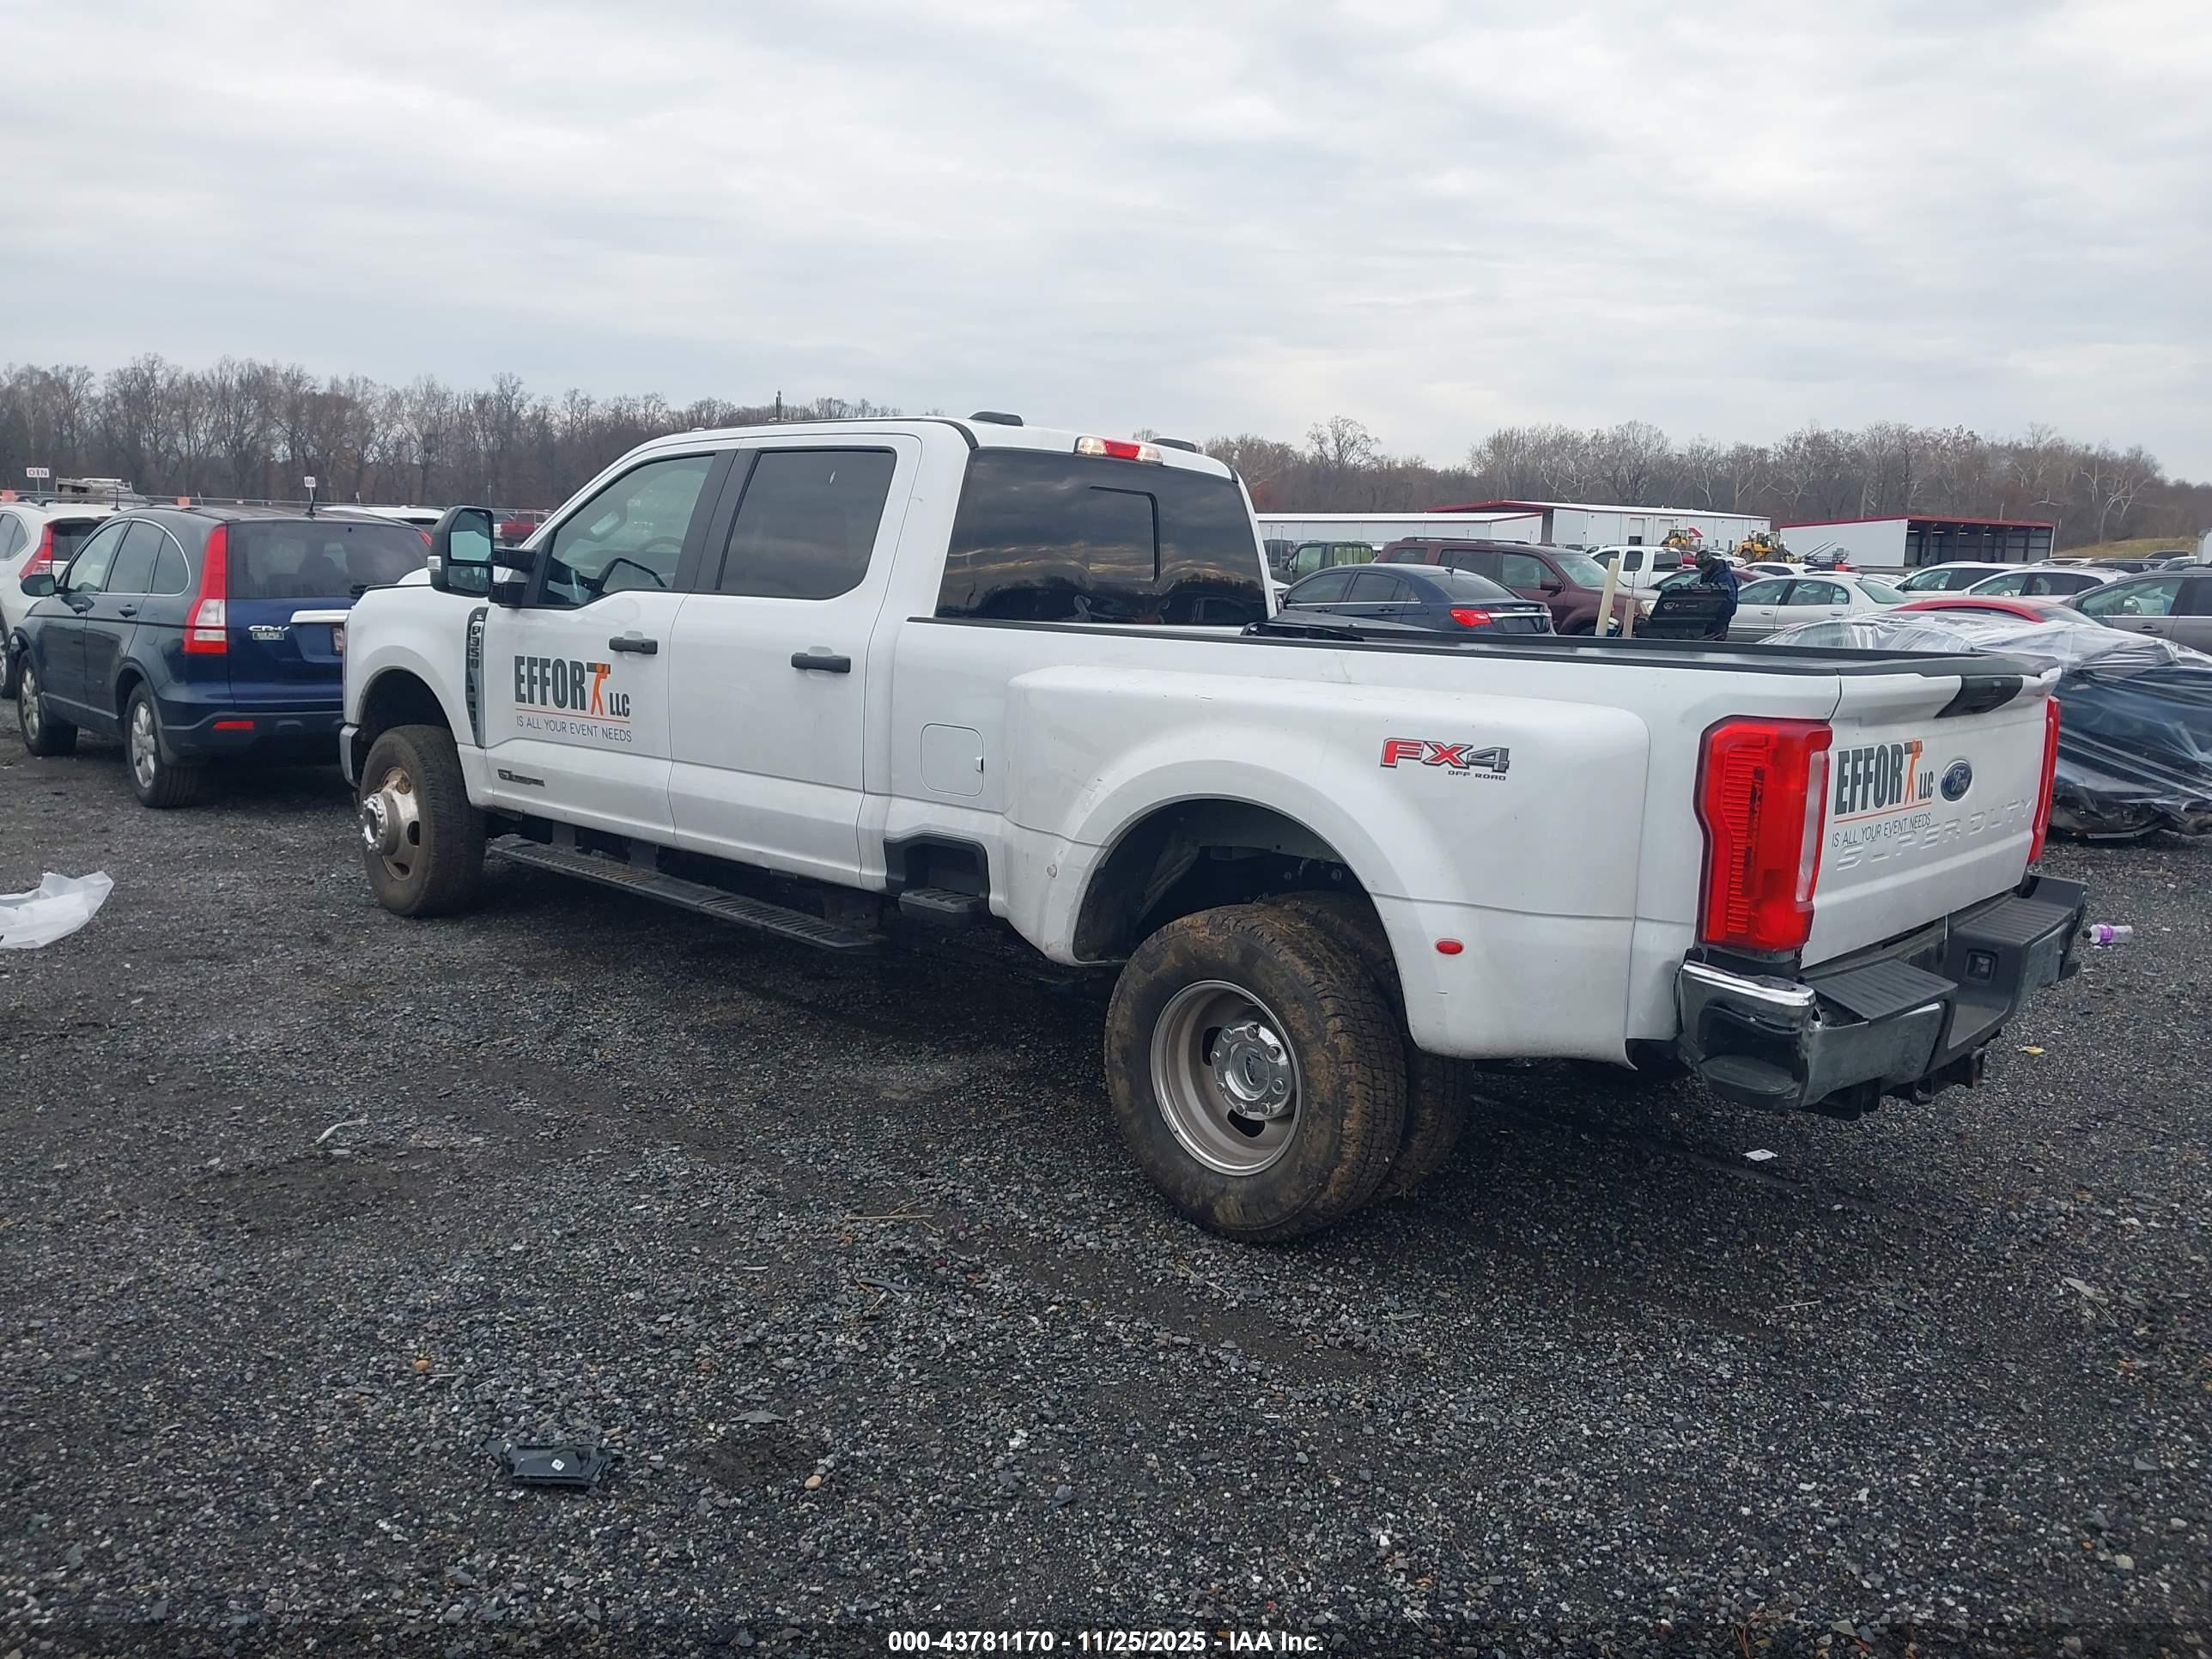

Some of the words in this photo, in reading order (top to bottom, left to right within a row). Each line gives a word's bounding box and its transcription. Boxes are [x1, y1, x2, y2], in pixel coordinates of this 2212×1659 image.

[514, 655, 611, 716] EFFORT
[609, 692, 630, 718] LLC
[516, 715, 524, 727] IS
[526, 718, 542, 730] ALL
[544, 720, 567, 733] YOUR
[570, 722, 599, 738] EVENT
[602, 727, 632, 743] NEEDS
[1381, 738, 1510, 773] FX4
[1475, 773, 1506, 781] ROAD
[1834, 739, 1923, 816] EFFORT
[1918, 771, 1934, 800] LLC
[1832, 832, 1839, 848] IS
[1842, 829, 1857, 847] ALL
[1862, 823, 1881, 842] YOUR
[1884, 817, 1907, 837] EVENT
[1910, 812, 1931, 832] NEEDS
[1836, 818, 1962, 871] SUPER
[1967, 796, 2033, 836] DUTY
